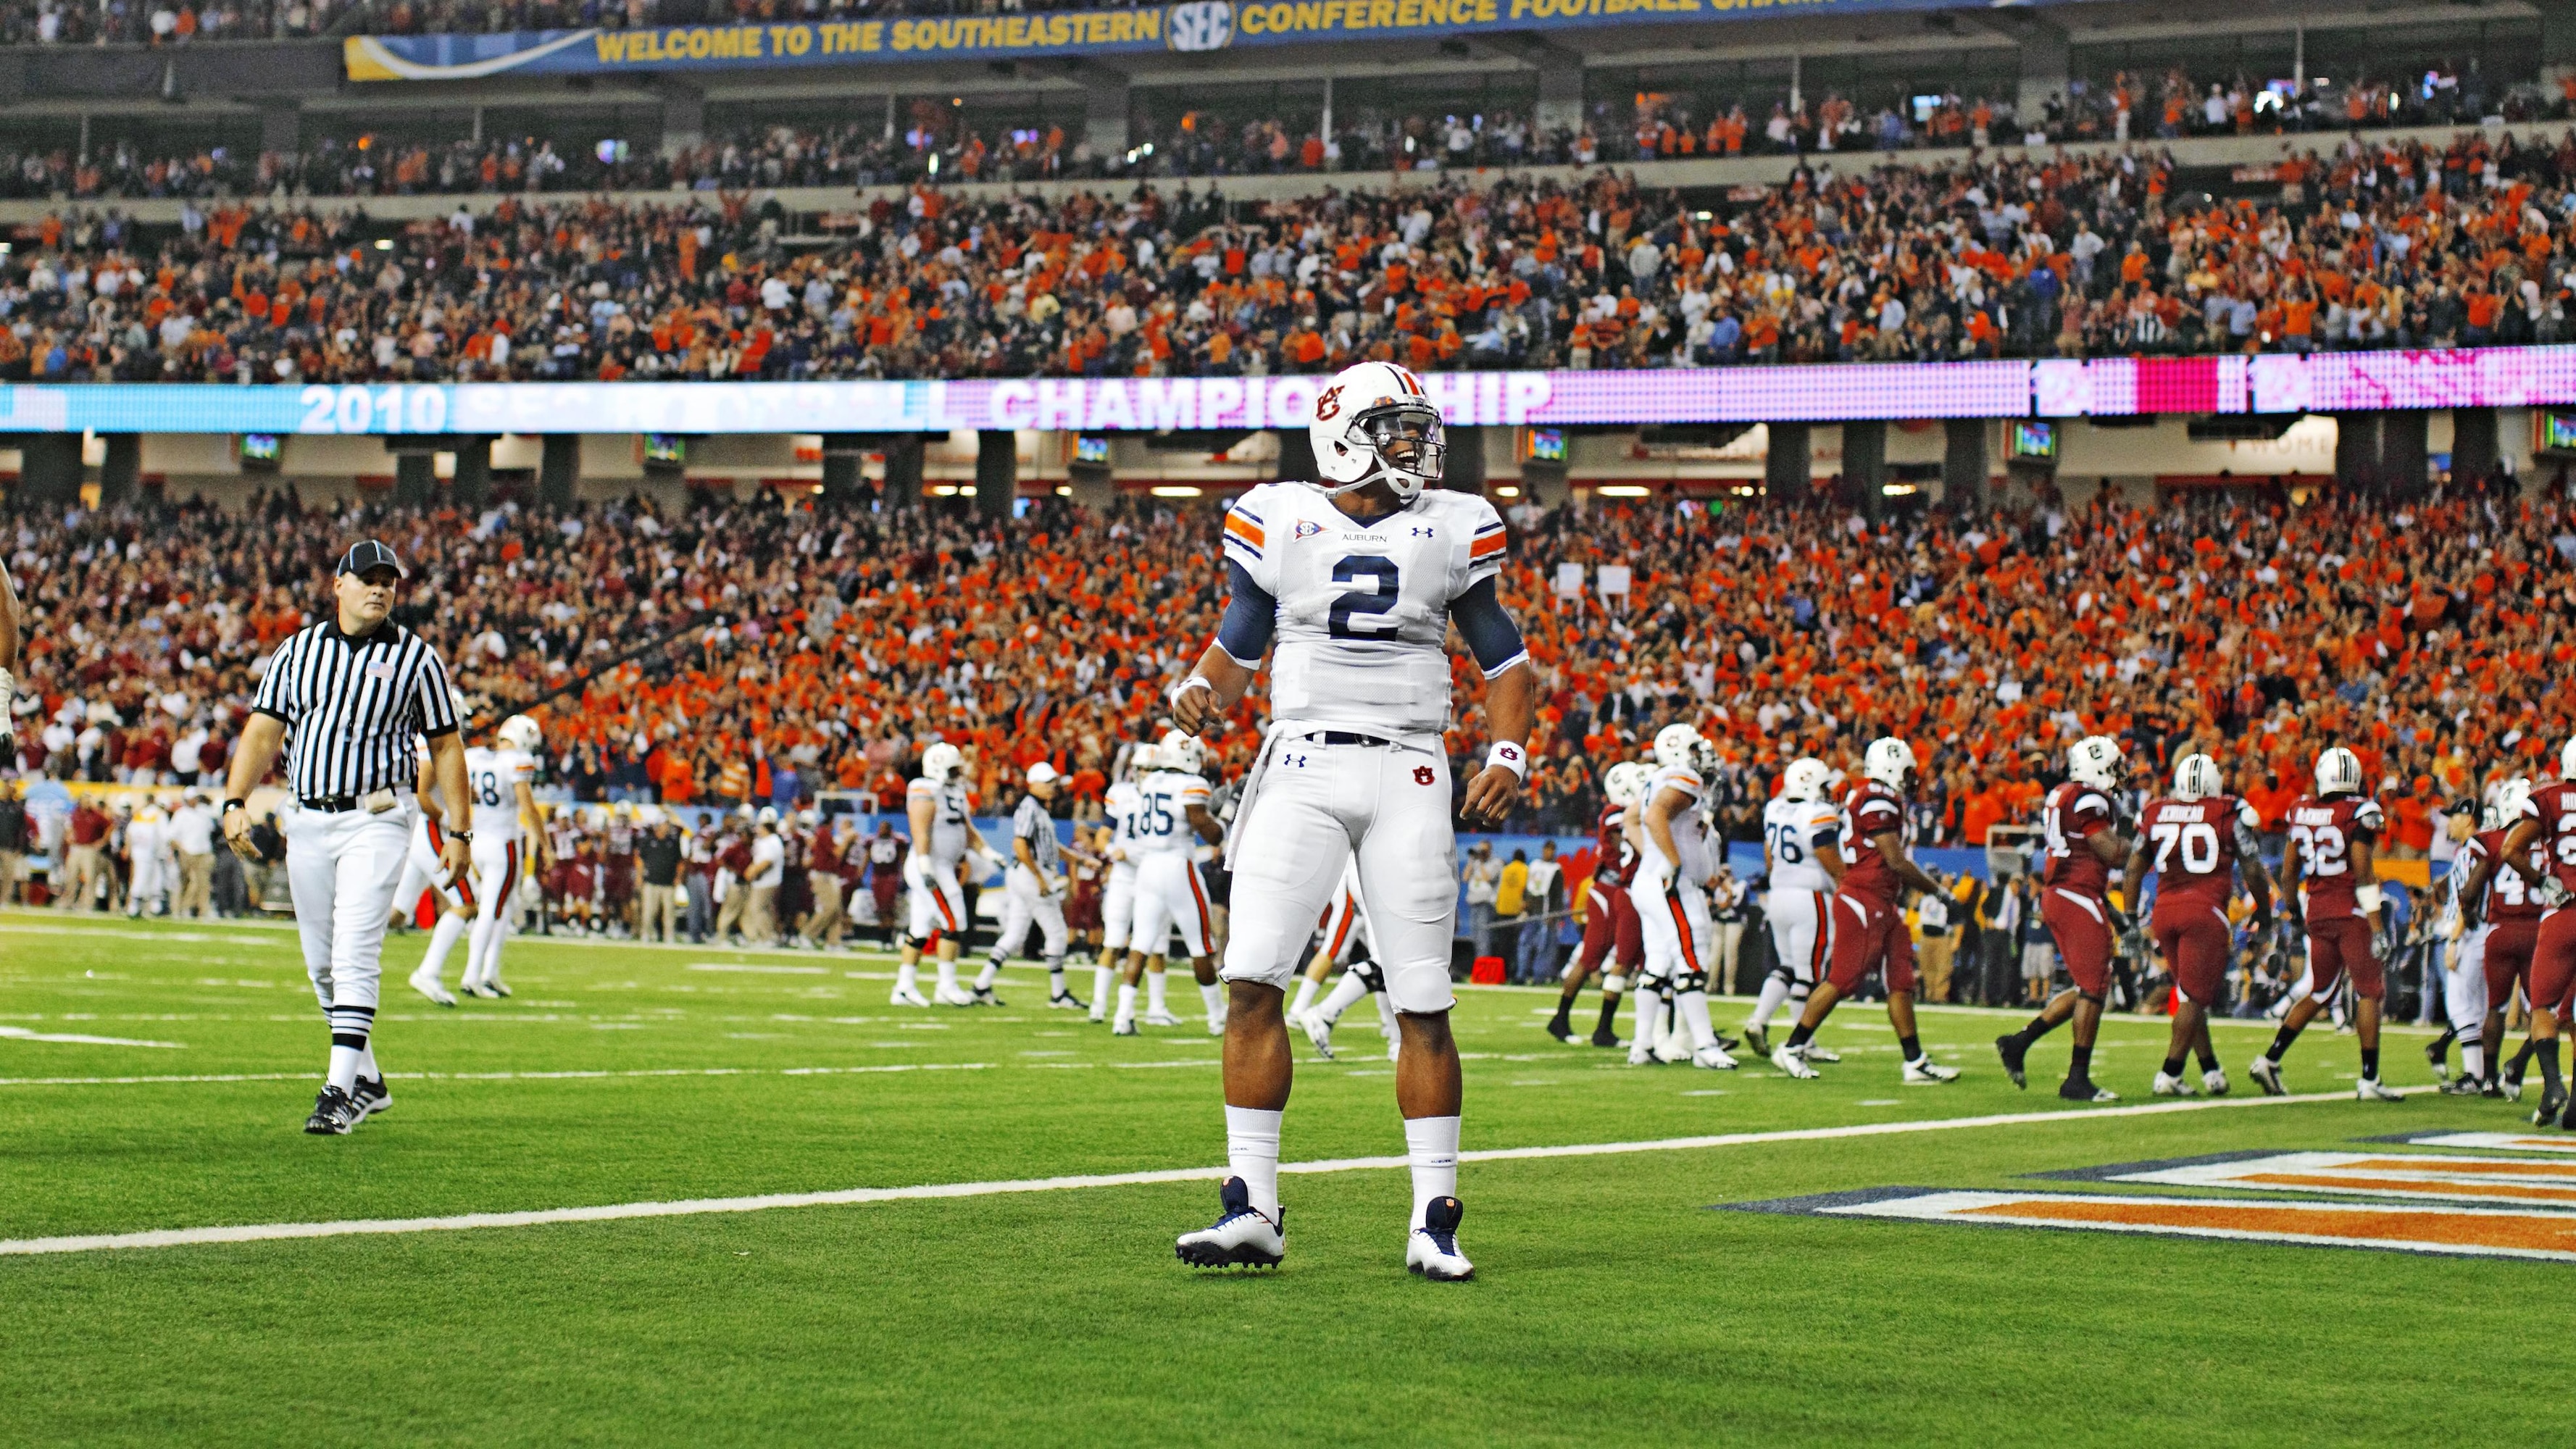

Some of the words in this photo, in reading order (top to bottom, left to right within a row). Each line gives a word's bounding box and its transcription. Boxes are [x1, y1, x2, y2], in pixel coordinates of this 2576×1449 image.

[596, 26, 762, 63] WELCOME
[770, 25, 812, 56] TO
[819, 21, 884, 54] THE
[891, 9, 1160, 52] SOUTHEASTERN
[1169, 1, 1230, 51] SEC
[1241, 0, 1497, 35] CONFERENCE
[299, 385, 447, 433] 2010
[988, 372, 1553, 431] CHAMPIOHIP
[1299, 522, 1315, 536] SEC
[1342, 534, 1388, 543] AUBURN
[1328, 555, 1399, 642] 2
[1141, 793, 1174, 836] 85
[1766, 822, 1804, 864] 76
[2150, 822, 2219, 874] 70
